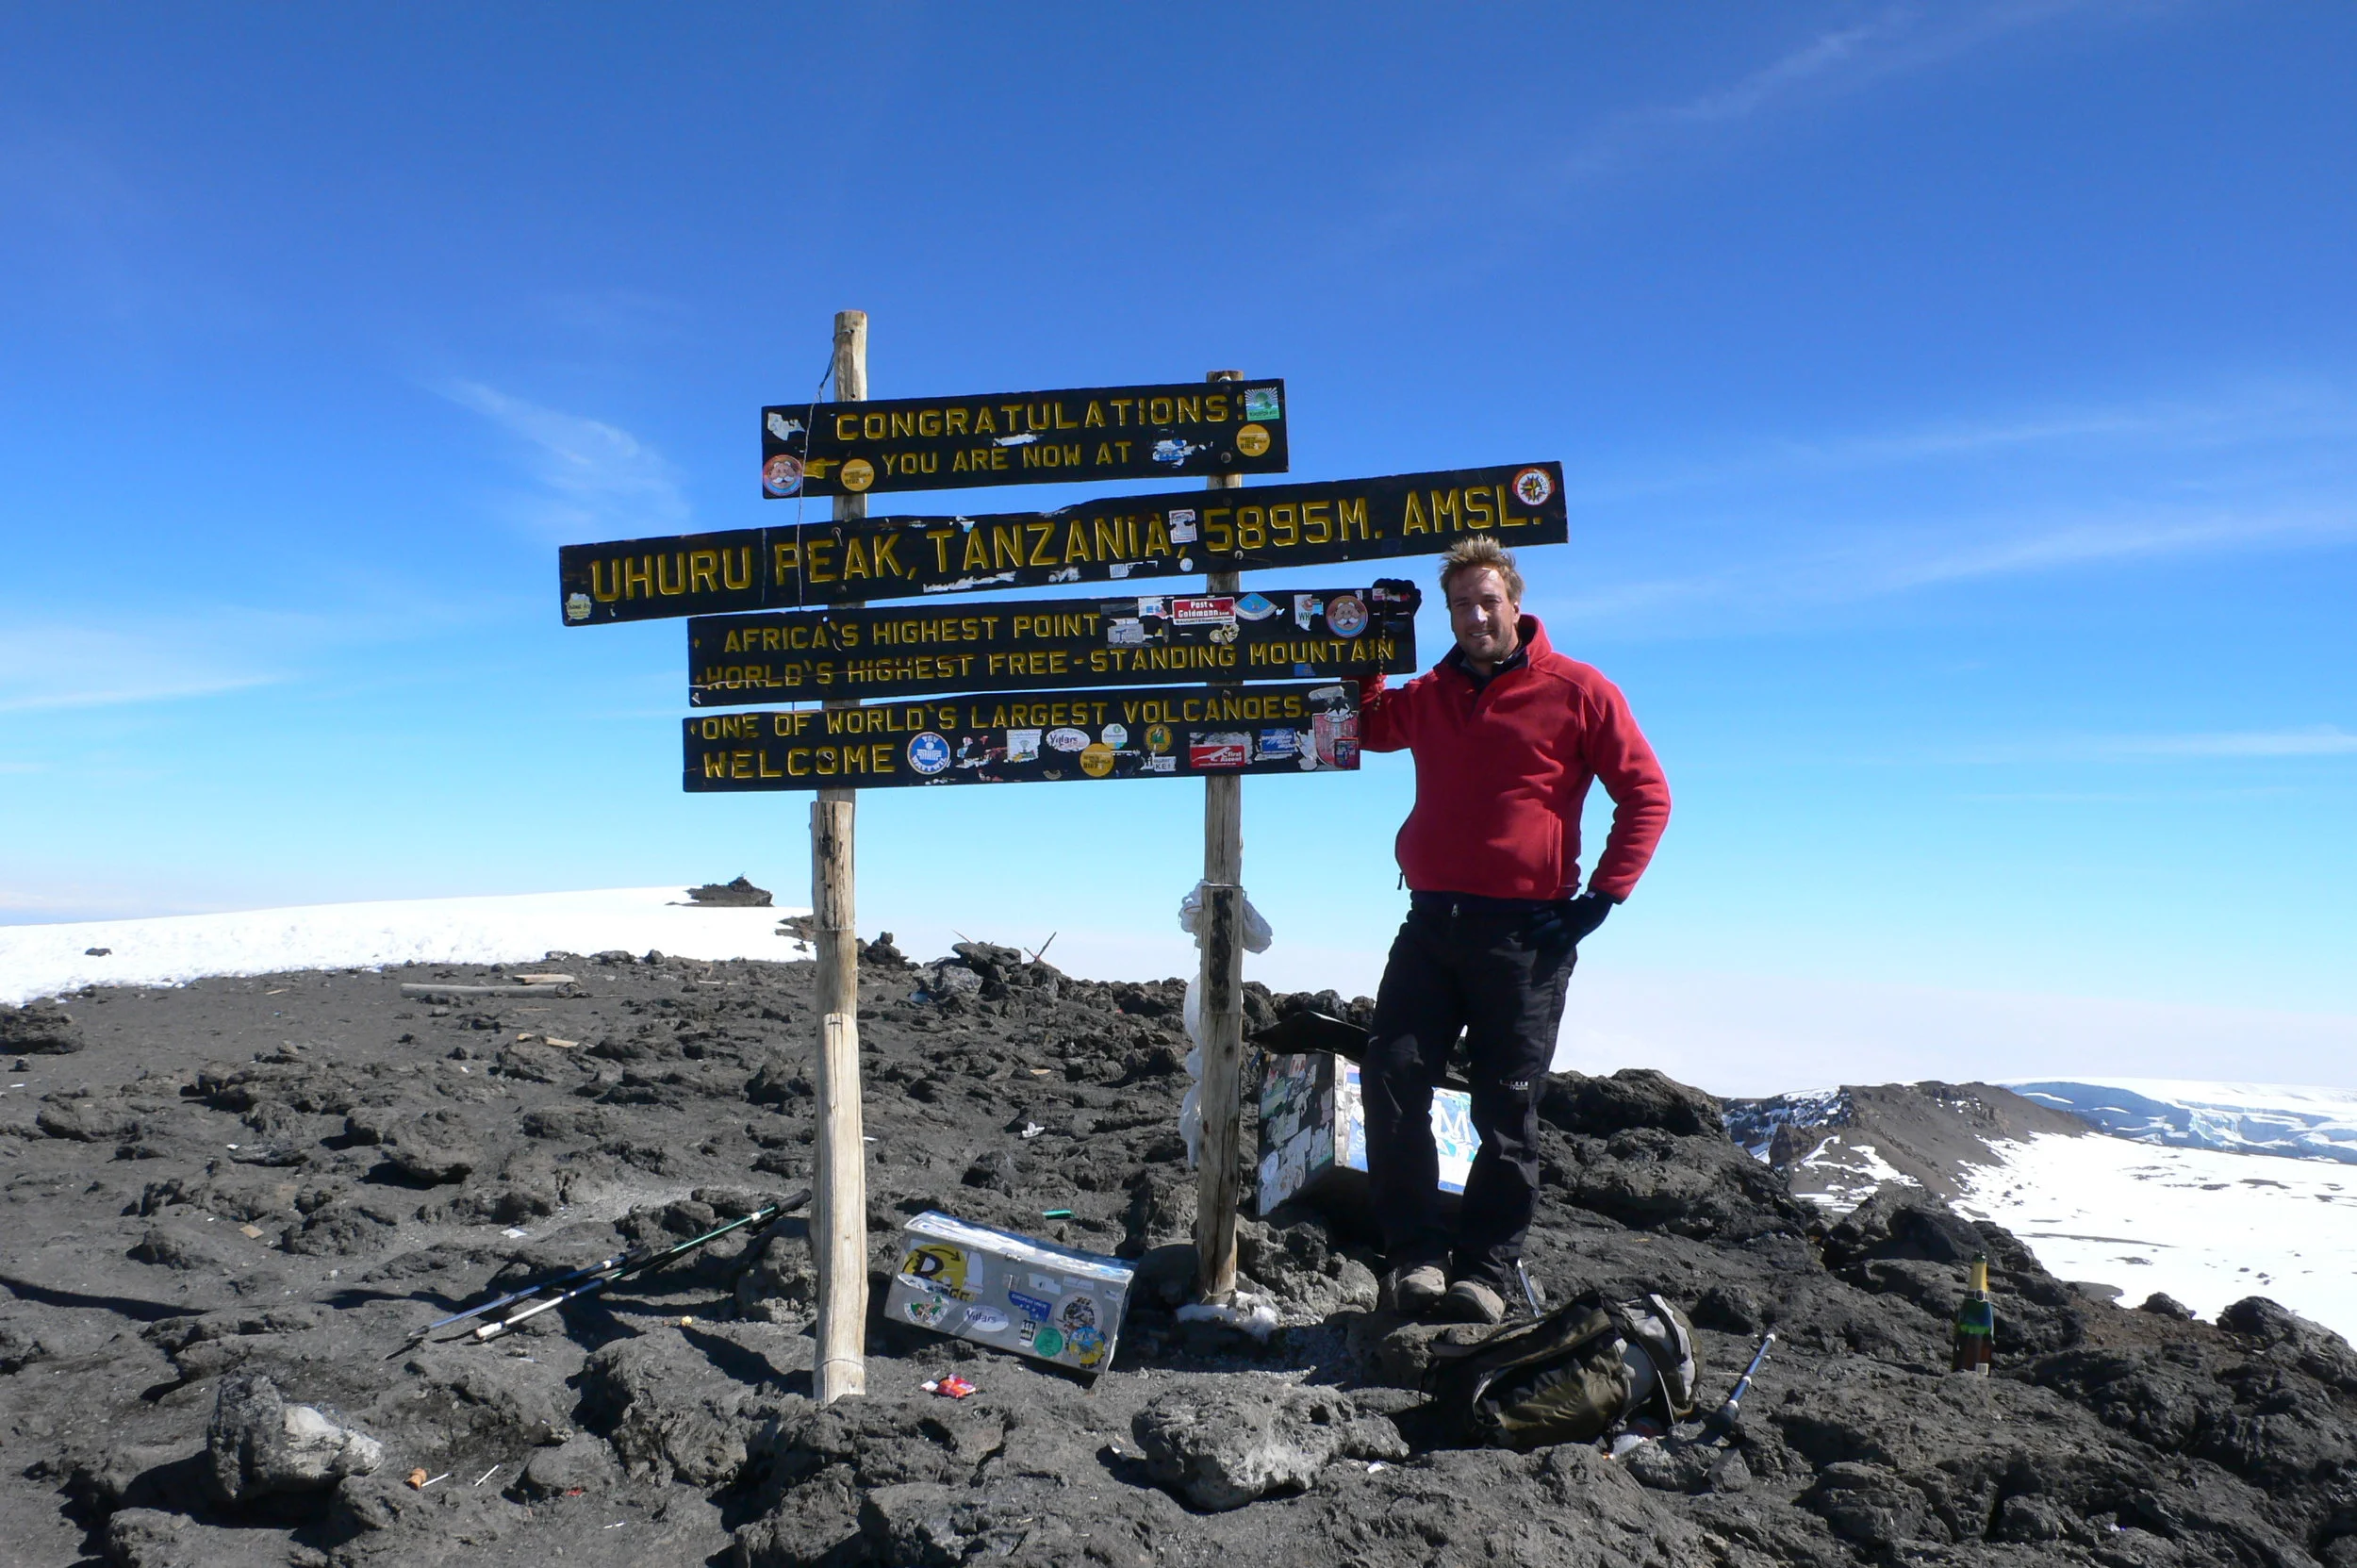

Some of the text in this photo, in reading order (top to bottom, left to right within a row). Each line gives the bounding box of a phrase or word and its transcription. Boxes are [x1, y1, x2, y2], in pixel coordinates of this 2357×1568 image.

[836, 393, 1244, 440] CONGRATULATIONS!
[882, 440, 1131, 476] YOU ARE NOW AT
[590, 484, 1543, 602] UHURU PEAK, TANZANIA, 5895M. AMSL.
[724, 620, 859, 653] AFRICA'S
[873, 615, 999, 645] HIGHEST
[1014, 612, 1101, 639] POINT
[706, 638, 1395, 691] WORLD'S HIGHEST FREE-STANDING MOUNTAIN
[702, 694, 1311, 739] ONE OF WORLD'S LARGEST VOLCANOES.
[704, 742, 896, 780] WELCOME
